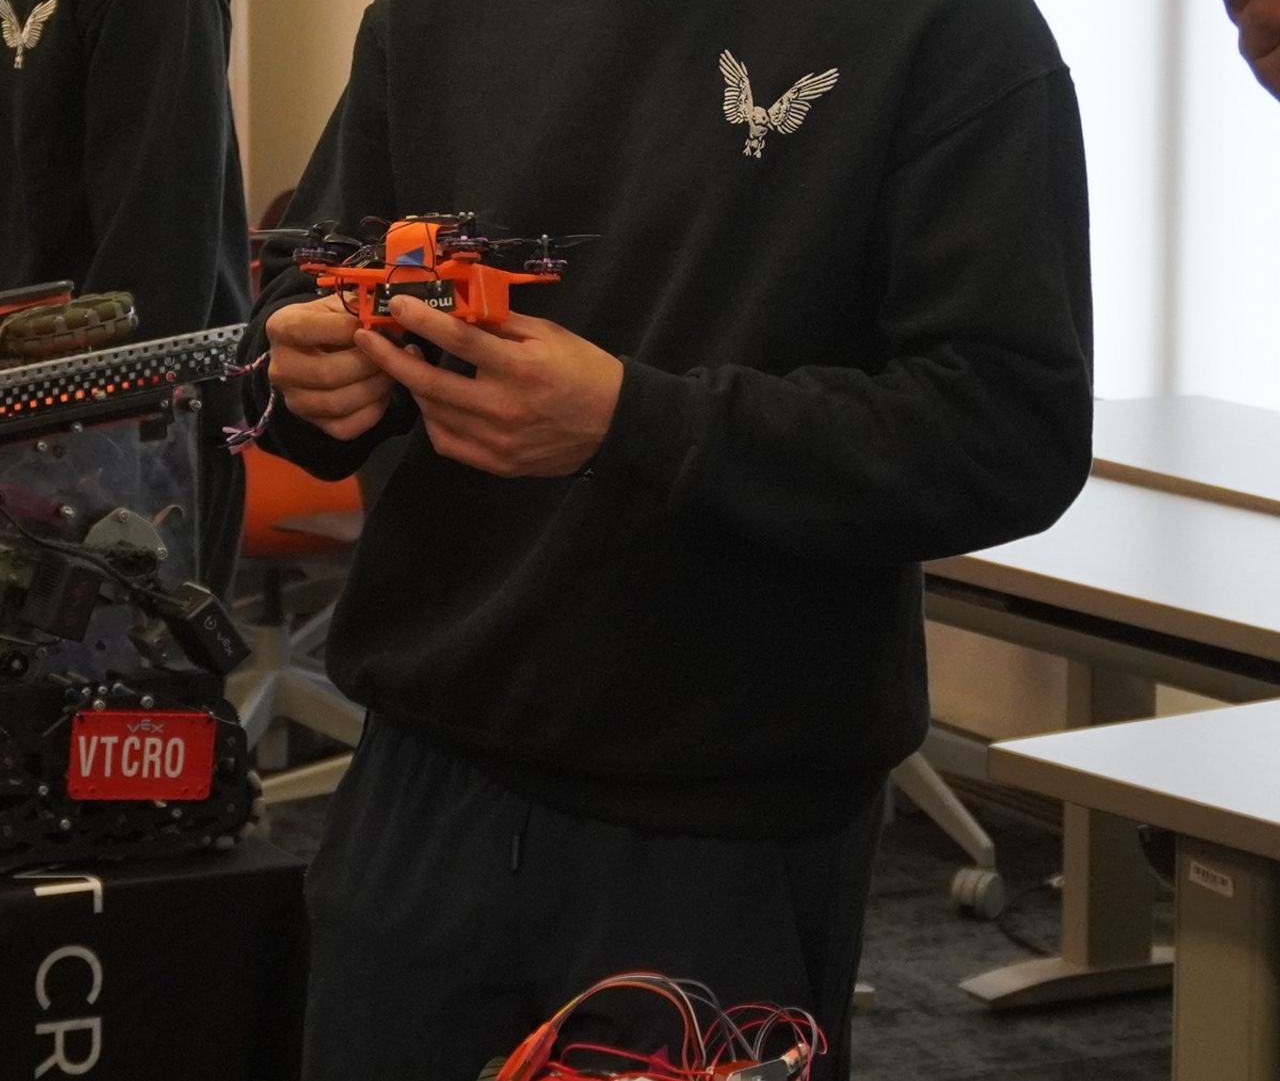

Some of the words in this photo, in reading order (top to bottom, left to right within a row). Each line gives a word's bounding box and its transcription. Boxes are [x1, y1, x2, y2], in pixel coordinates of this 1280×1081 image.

[424, 296, 453, 309] mo
[126, 718, 165, 734] VEX
[78, 735, 185, 779] VTCRO
